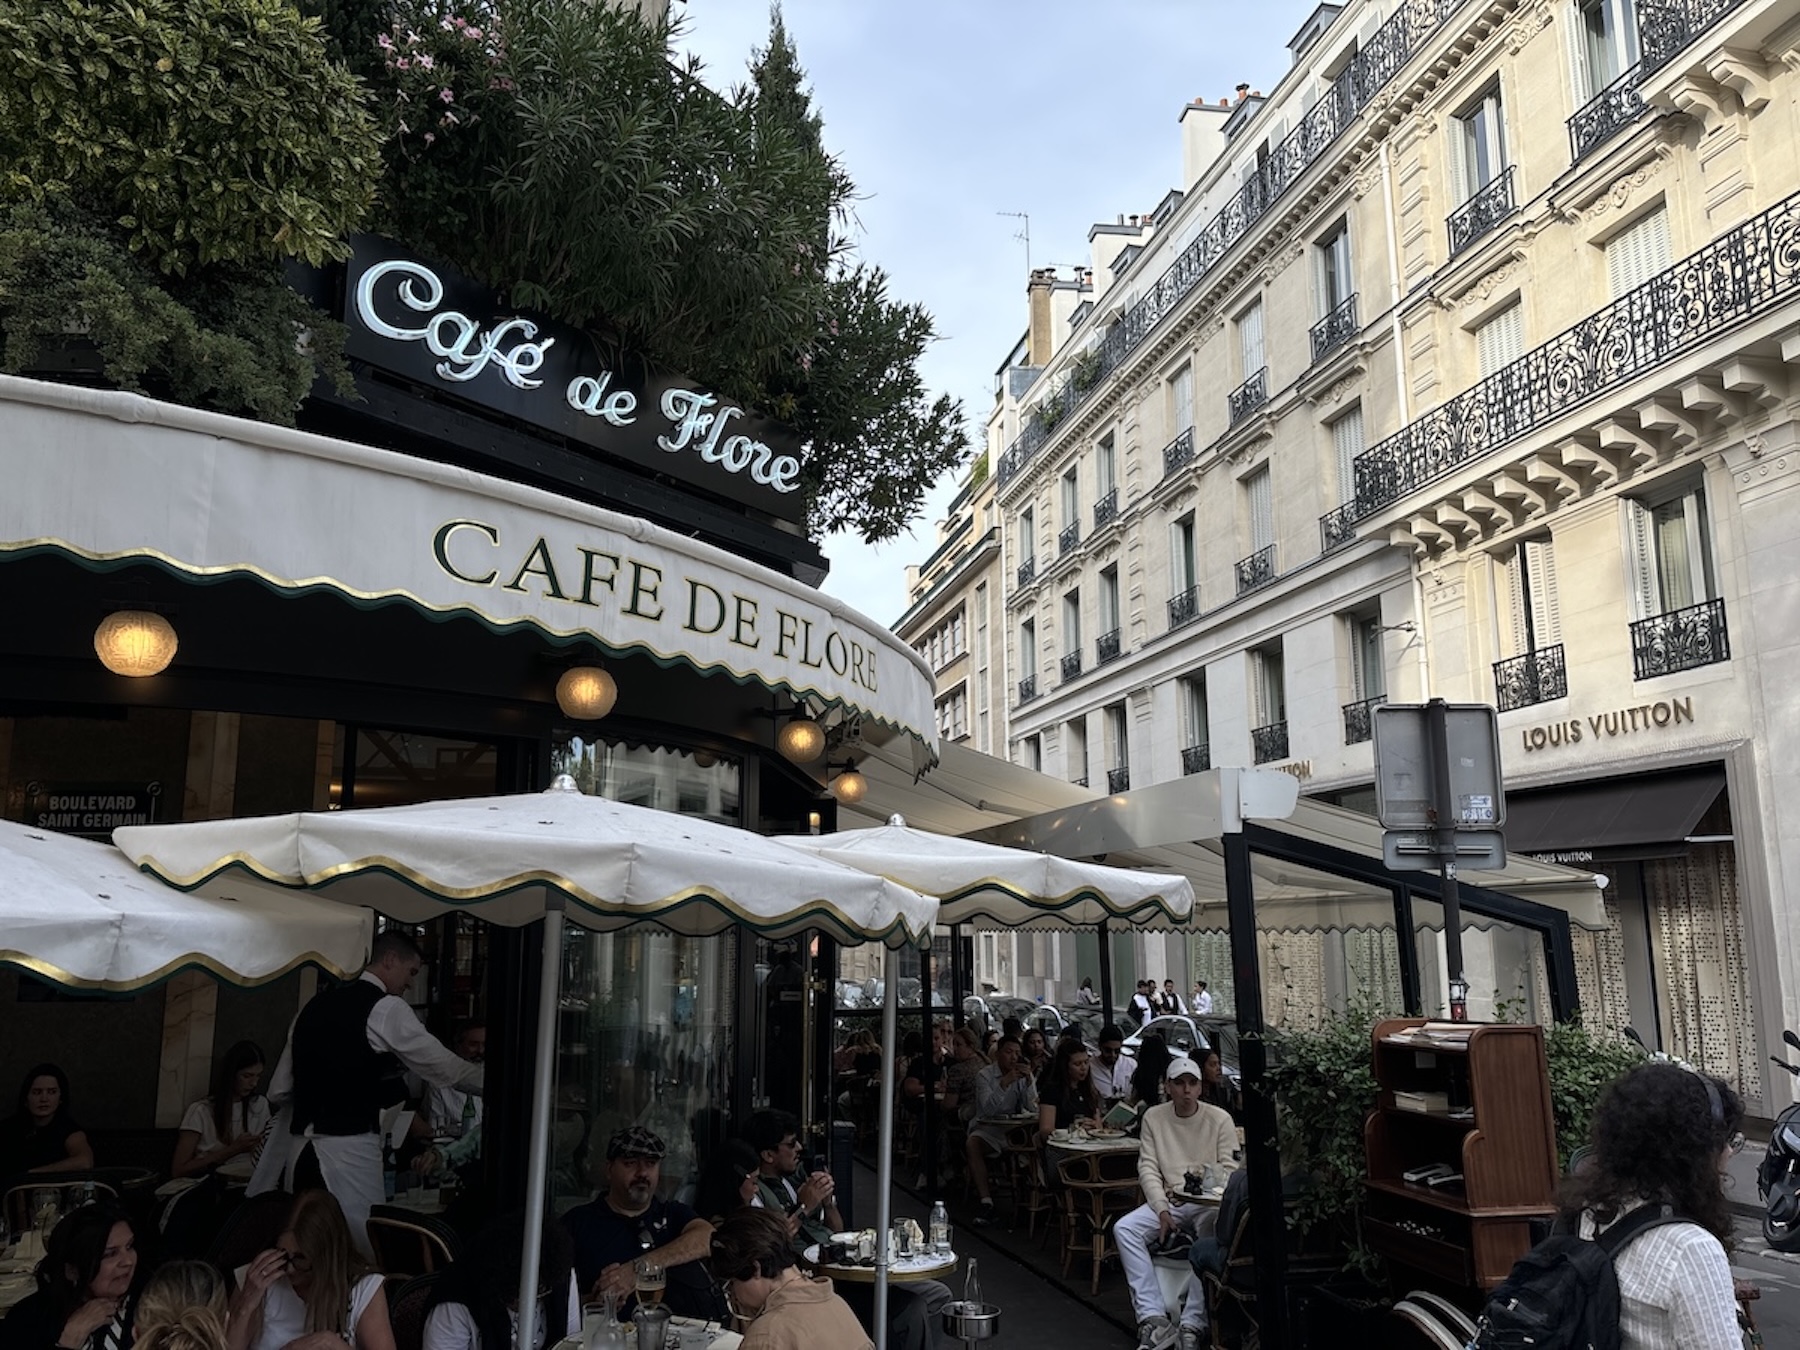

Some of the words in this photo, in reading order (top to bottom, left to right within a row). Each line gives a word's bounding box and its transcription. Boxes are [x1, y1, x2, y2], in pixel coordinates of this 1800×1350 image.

[356, 260, 555, 390] Café
[566, 370, 637, 427] de
[657, 387, 800, 493] Flore
[431, 518, 666, 623] CAFE
[683, 578, 761, 651] DE
[774, 609, 878, 695] FLORE
[1522, 720, 1583, 752] LOUIS
[1588, 696, 1695, 740] VUITTON
[37, 813, 80, 828] SAINT
[82, 813, 147, 828] GERMAIN
[49, 796, 136, 811] BOULEVARD
[1557, 851, 1592, 862] VUITTON
